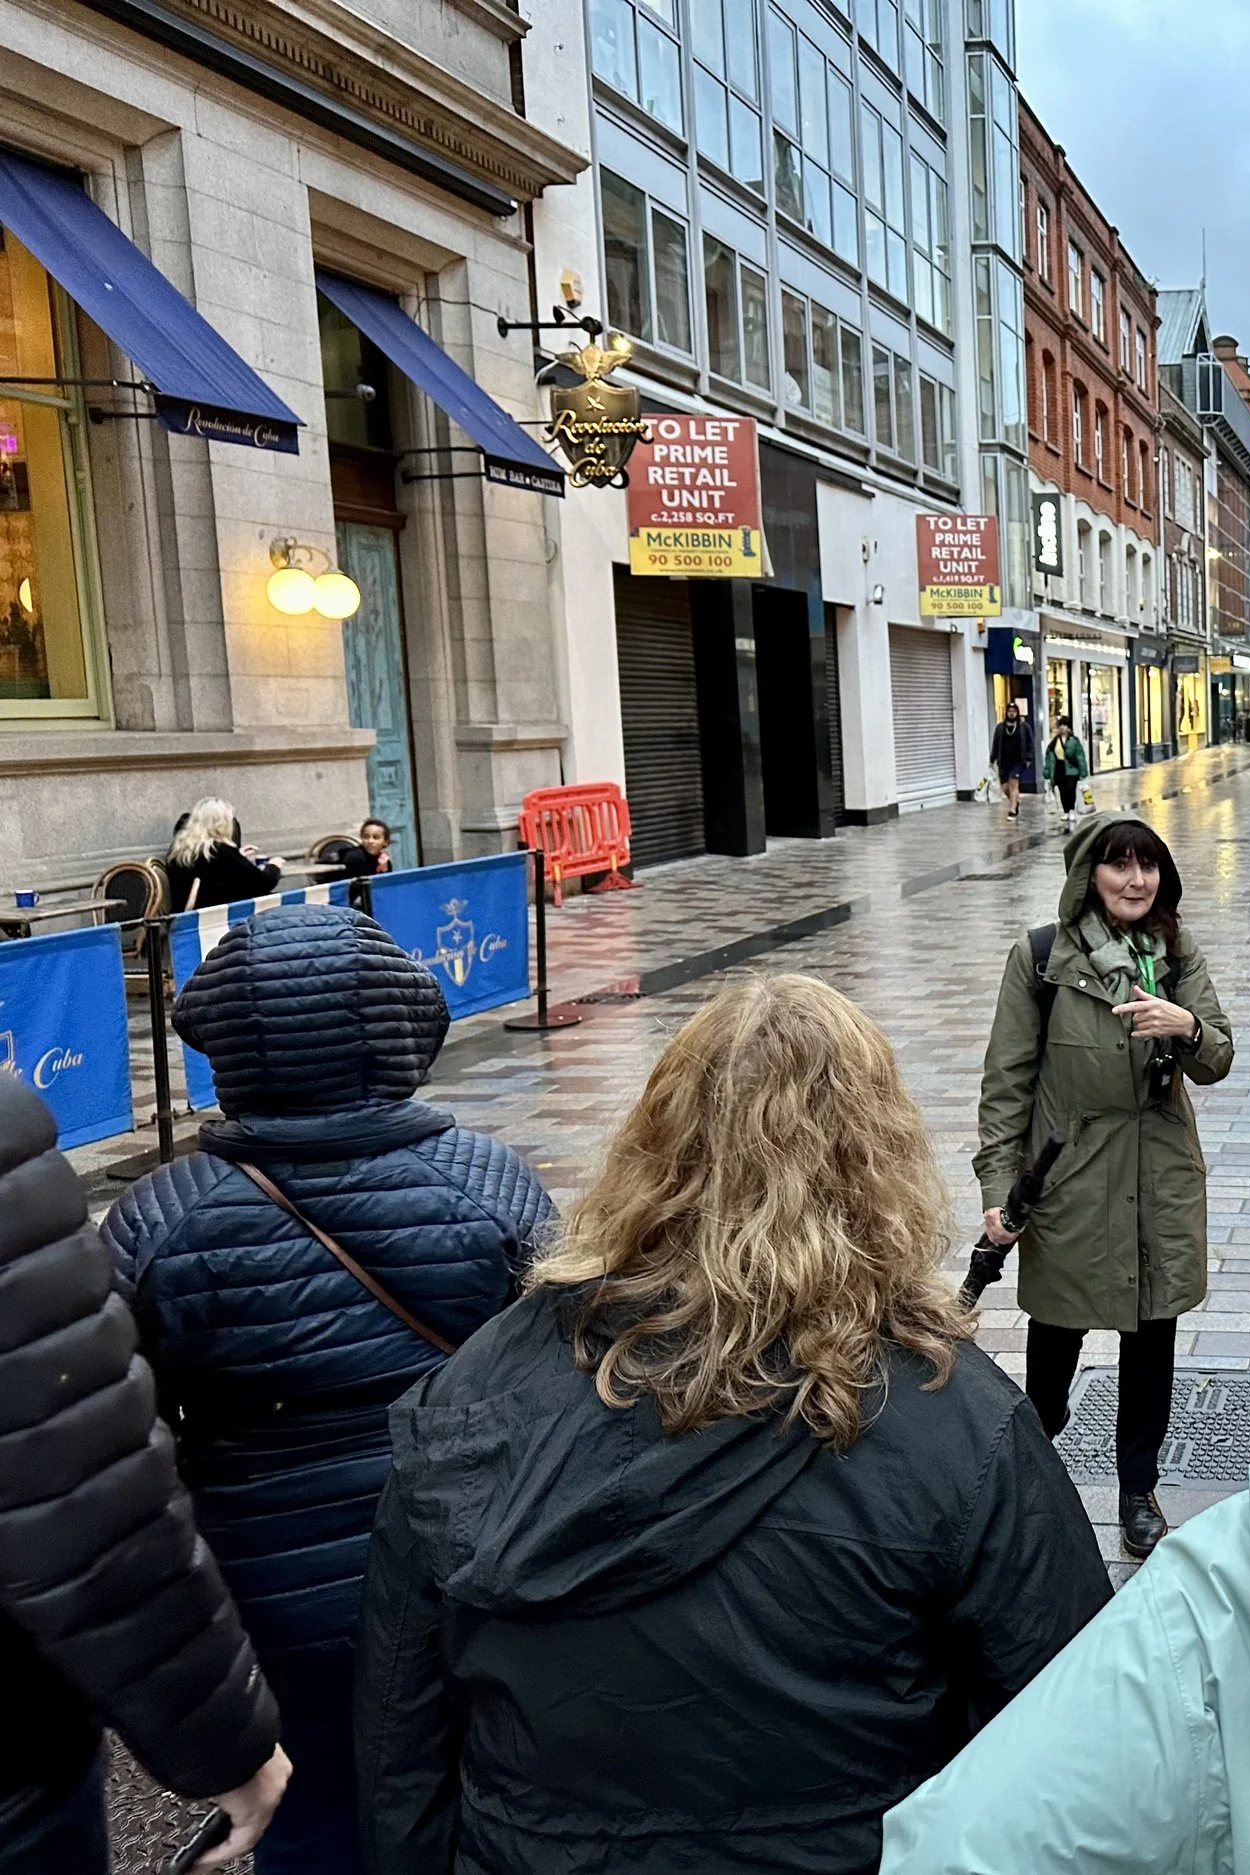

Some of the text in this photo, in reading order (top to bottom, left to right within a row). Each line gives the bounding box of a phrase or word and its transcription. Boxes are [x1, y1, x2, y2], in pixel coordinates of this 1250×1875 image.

[641, 418, 740, 442] TO LET
[653, 444, 728, 464] PRIME
[569, 457, 619, 487] Cuba
[648, 467, 737, 487] RETAIL
[661, 489, 725, 509] UNIT
[650, 512, 736, 525] c.2,258 SQ.FT
[926, 516, 988, 531] TO LET
[646, 532, 732, 549] McKIBBIN
[935, 533, 981, 545] PRIME
[648, 554, 732, 567] 90 500 100
[931, 547, 986, 560] RETAIL
[939, 561, 979, 573] UNIT
[930, 588, 983, 598] McKIBBIN
[930, 602, 983, 610] 90 500 100
[33, 1047, 83, 1089] Cuba
